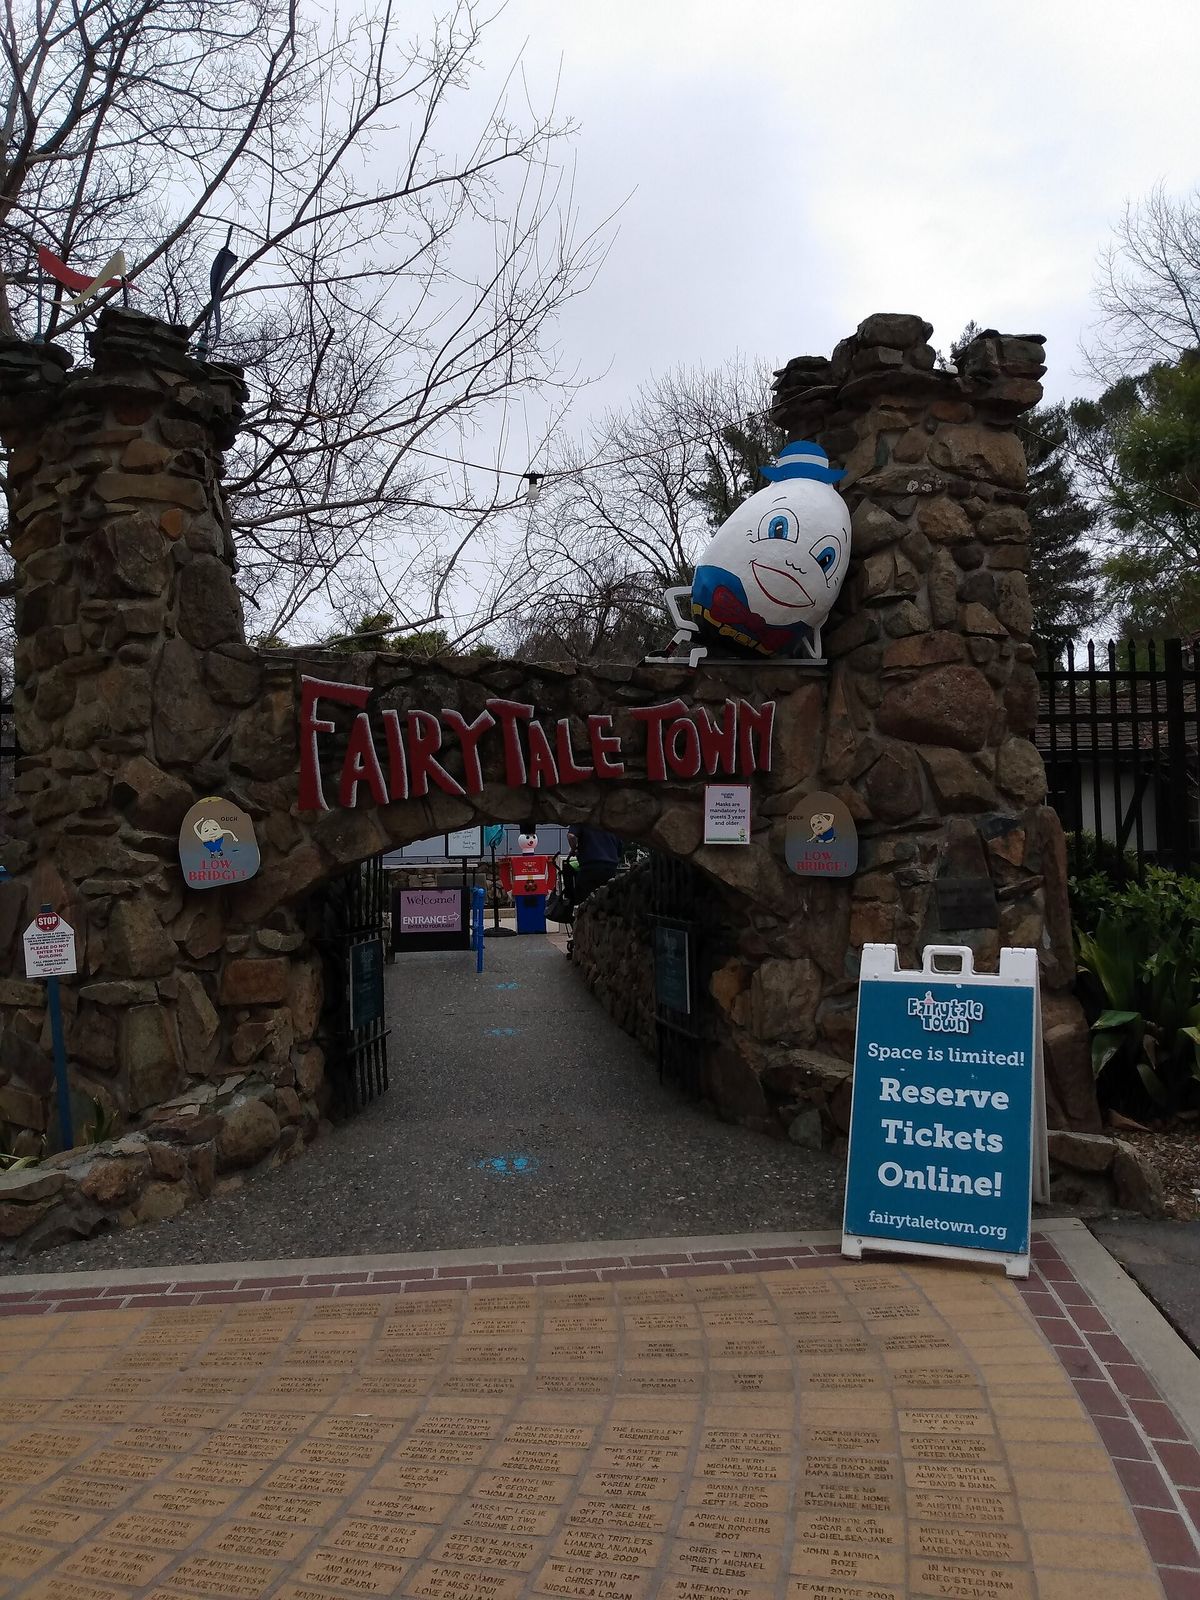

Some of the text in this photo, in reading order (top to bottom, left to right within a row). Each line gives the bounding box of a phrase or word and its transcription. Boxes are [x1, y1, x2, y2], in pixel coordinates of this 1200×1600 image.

[299, 674, 777, 811] FAIRYTALE TOWN
[804, 851, 832, 860] LOW
[201, 859, 232, 870] LOW
[406, 895, 456, 906] Welcome!
[38, 916, 57, 926] STOP
[403, 916, 447, 925] ENTRANCE
[907, 996, 984, 1021] Fairytale
[922, 1015, 970, 1034] Town
[867, 1043, 1025, 1067] Space is limited!
[879, 1077, 1010, 1110] Reserve
[881, 1118, 1003, 1153] Tickets
[877, 1162, 1002, 1197] Online!
[868, 1210, 1008, 1240] fairytaletown.org
[600, 1480, 630, 1488] KAREN
[804, 1491, 835, 1499] PLACE
[863, 1494, 890, 1503] HOME
[402, 1503, 436, 1512] FAMILY
[472, 1511, 492, 1519] FIVE
[517, 1516, 537, 1524] TWO
[570, 1516, 604, 1524] WIZARD
[615, 1511, 634, 1519] SEE
[638, 1512, 657, 1520] THE
[463, 1519, 536, 1533] SUNSHINE LOVE
[698, 1522, 725, 1530] OWEN
[810, 1523, 842, 1532] OSCAR
[608, 1534, 654, 1546] TRIPLETS
[715, 1532, 740, 1540] 2007
[356, 1541, 377, 1550] MOM
[444, 1542, 470, 1551] KEEP
[689, 1546, 717, 1555] CHRIS
[566, 1550, 592, 1558] JUNE
[803, 1547, 829, 1556] JOHN
[679, 1554, 765, 1570] CHRISTY MICHAEL
[440, 1569, 461, 1579] OUR
[551, 1564, 617, 1579] WE LOVE YOU
[690, 1565, 710, 1574] THE
[830, 1568, 857, 1577] 2007
[928, 1564, 1003, 1578] IN MEMORY OF
[429, 1578, 443, 1586] WE
[448, 1580, 470, 1590] MISS
[564, 1575, 616, 1589] CHRISTIAN
[796, 1582, 825, 1593] TEAM
[598, 1589, 633, 1600] LOGAN
[675, 1581, 751, 1597] IN MEMORY OF
